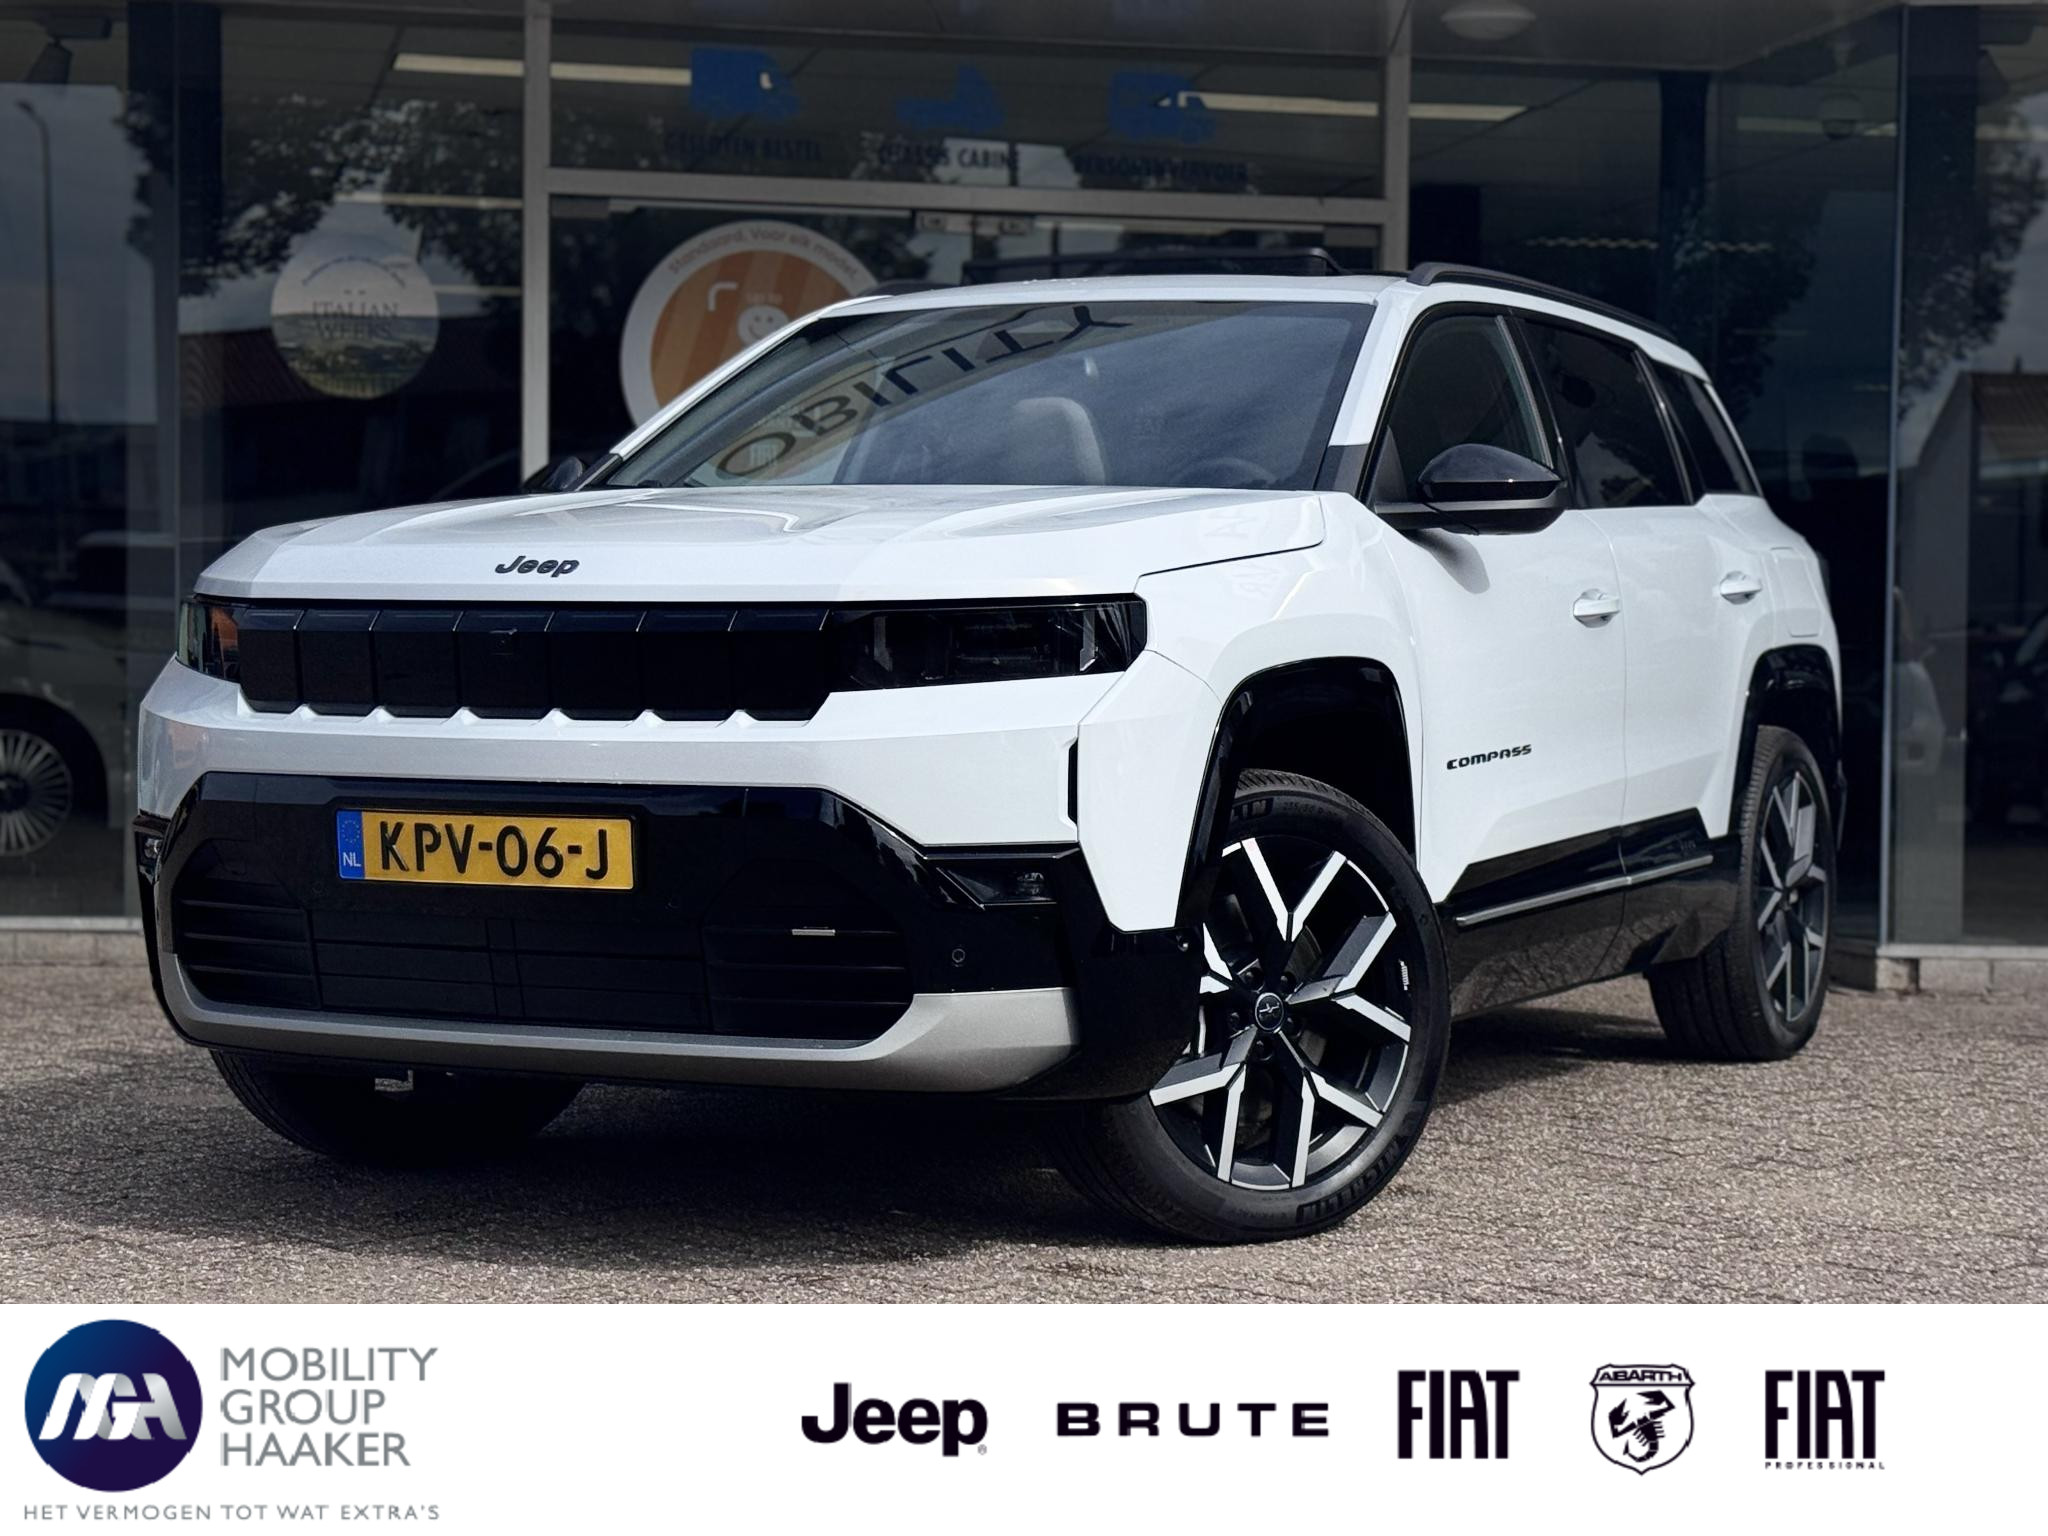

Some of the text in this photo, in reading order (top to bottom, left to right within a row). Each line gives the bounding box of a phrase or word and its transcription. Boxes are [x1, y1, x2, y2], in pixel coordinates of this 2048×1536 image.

[750, 228, 786, 241] Voor
[311, 300, 400, 319] ITALIAN
[494, 555, 580, 578] Jeep
[1446, 744, 1532, 770] COMPASS
[342, 852, 362, 868] NL
[379, 820, 609, 880] KPV-06-J
